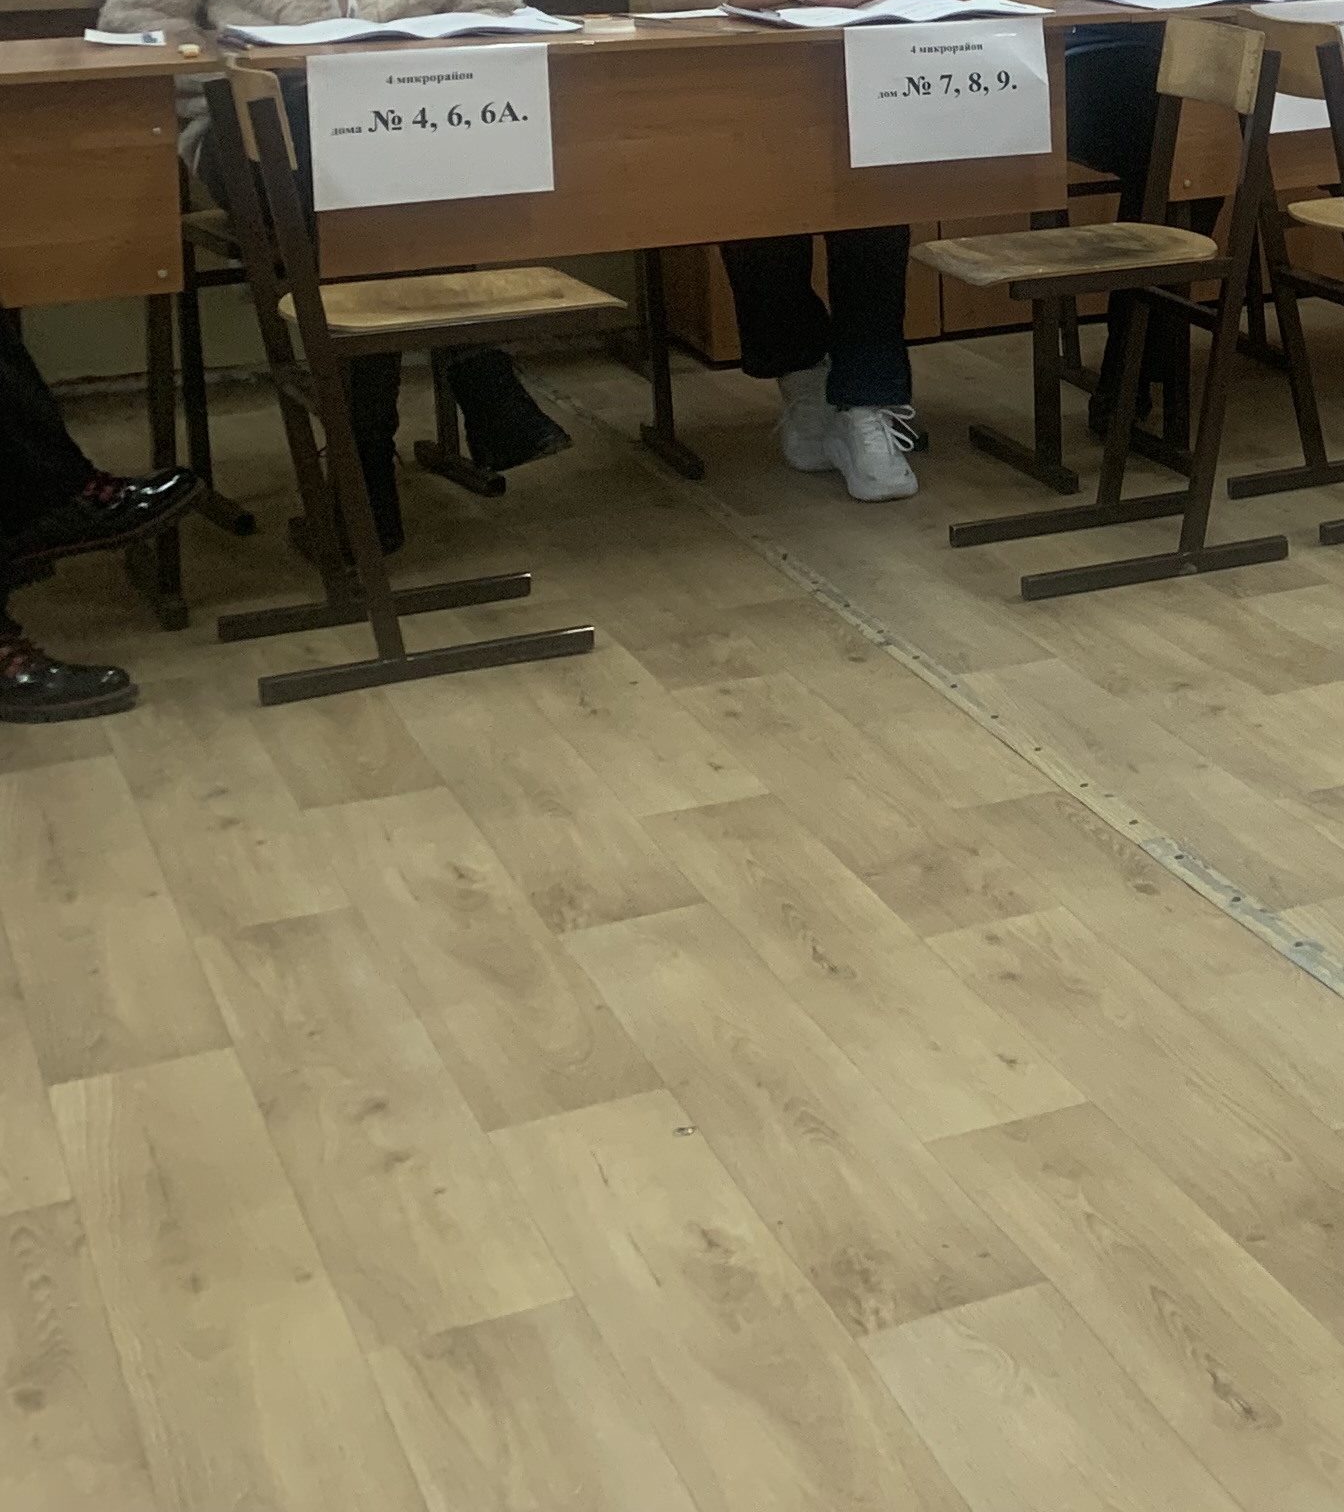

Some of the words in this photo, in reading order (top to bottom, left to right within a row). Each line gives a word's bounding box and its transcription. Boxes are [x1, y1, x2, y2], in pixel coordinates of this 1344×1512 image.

[910, 45, 917, 54] 4
[919, 43, 983, 55] микрорайон
[386, 74, 393, 85] 4
[396, 71, 473, 86] микрорайон
[902, 76, 931, 97] №
[939, 74, 961, 98] 7,
[968, 72, 989, 96] 8,
[997, 70, 1018, 91] 9.
[368, 109, 402, 133] №
[412, 106, 438, 133] 4,
[447, 104, 472, 129] 6,
[480, 101, 529, 124] 6А.
